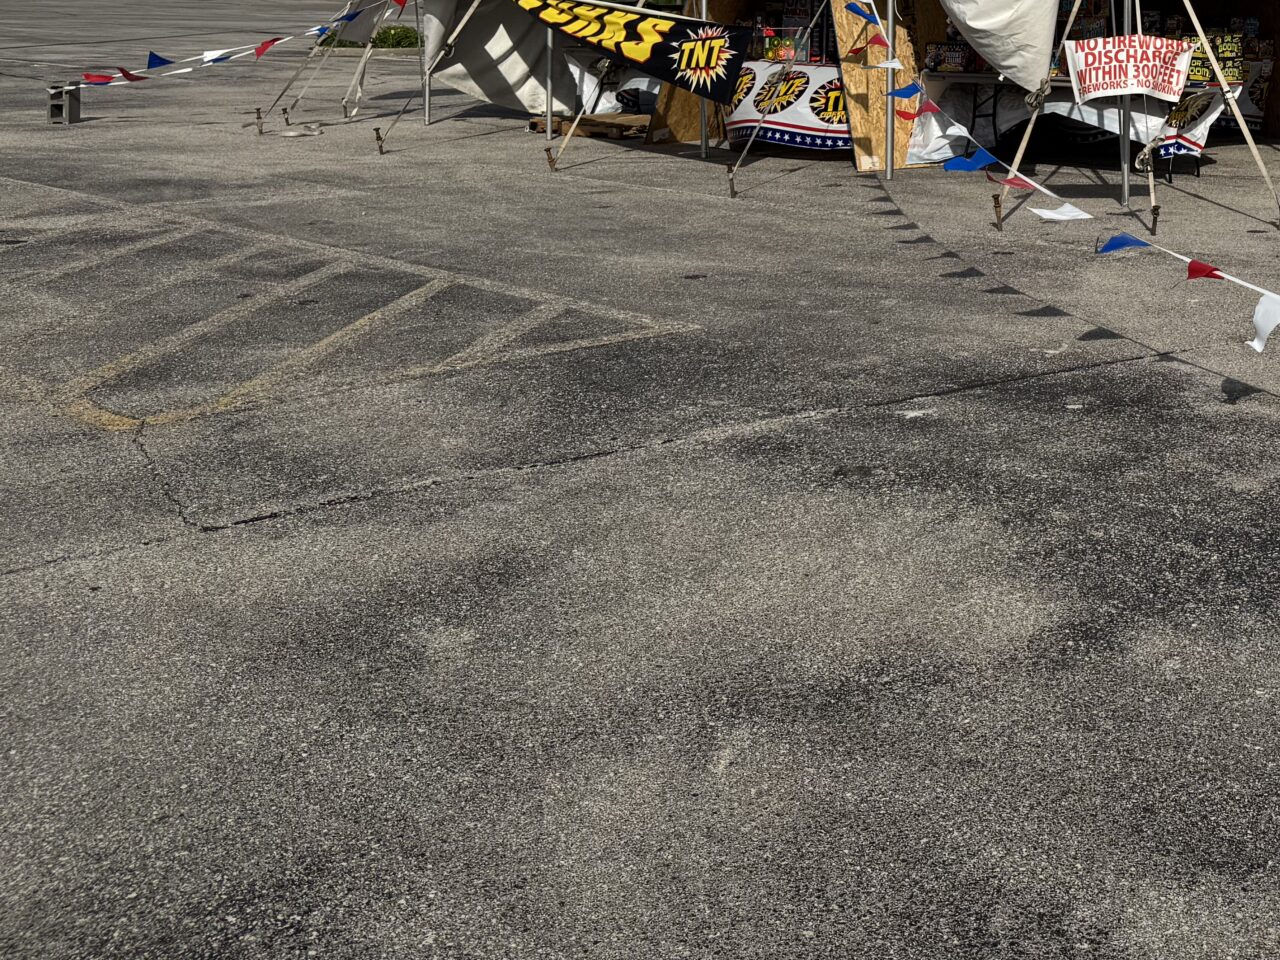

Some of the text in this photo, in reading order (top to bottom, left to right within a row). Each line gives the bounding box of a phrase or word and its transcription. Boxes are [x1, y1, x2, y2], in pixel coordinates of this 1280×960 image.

[679, 38, 727, 70] TNT
[1075, 38, 1099, 53] NO
[1085, 49, 1181, 67] DISCHARGE
[1077, 64, 1129, 86] WITHIN
[1137, 79, 1151, 89] NO
